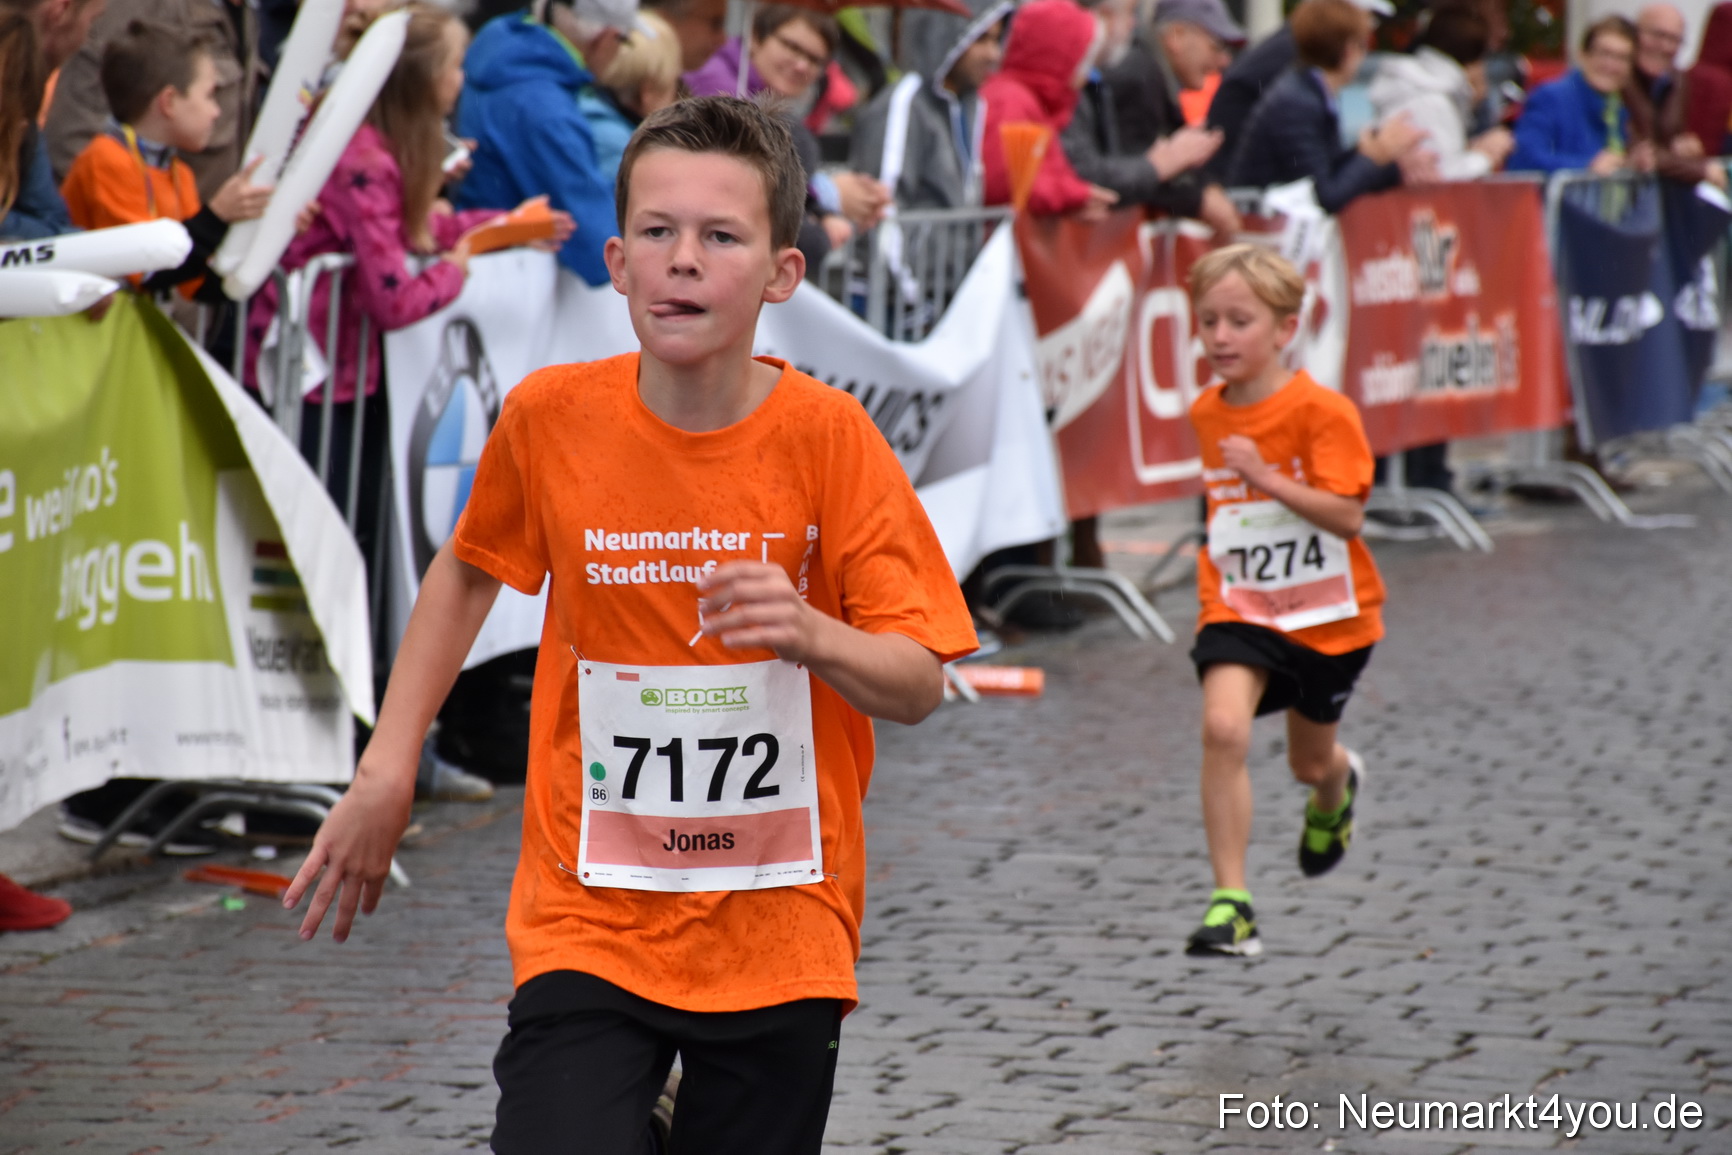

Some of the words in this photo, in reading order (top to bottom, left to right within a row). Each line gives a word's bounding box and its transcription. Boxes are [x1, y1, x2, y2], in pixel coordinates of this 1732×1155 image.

[584, 526, 750, 551] Neumarkter
[799, 525, 818, 600] BAMB
[1228, 534, 1326, 582] 7274
[585, 560, 717, 584] Stadtlauf
[664, 686, 749, 707] BOCK
[722, 705, 750, 713] concepts
[613, 733, 780, 803] 7172
[592, 788, 607, 801] B6
[663, 829, 735, 852] Jonas
